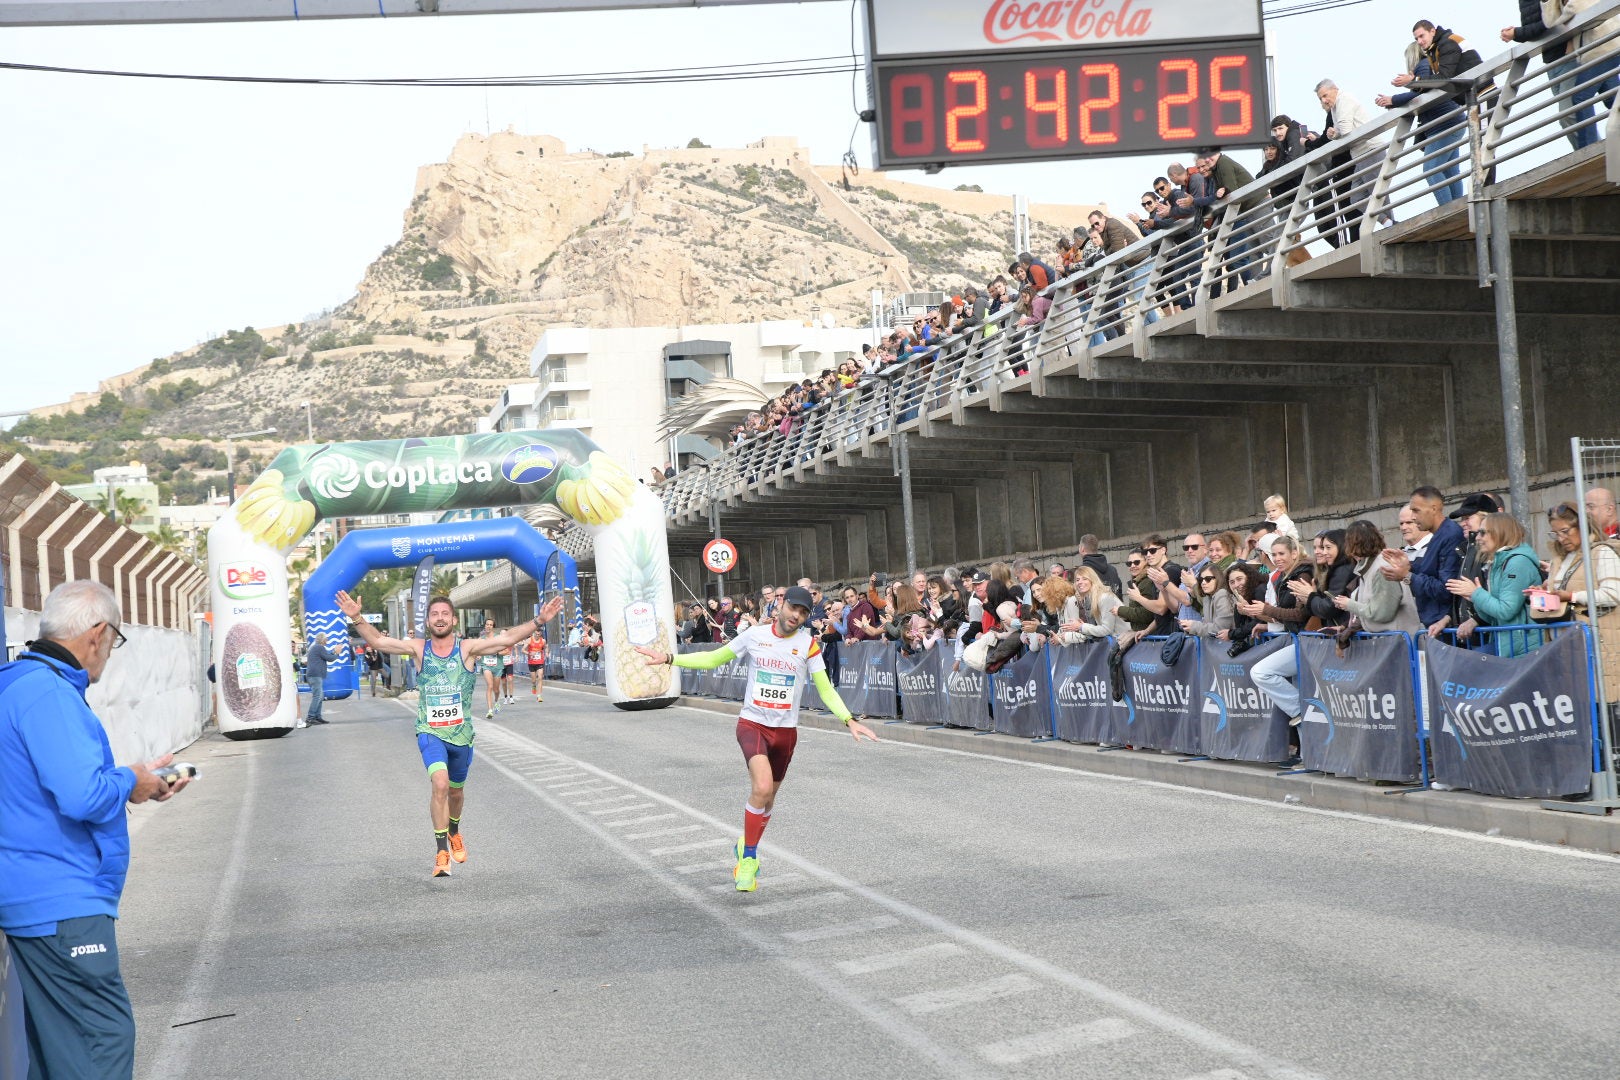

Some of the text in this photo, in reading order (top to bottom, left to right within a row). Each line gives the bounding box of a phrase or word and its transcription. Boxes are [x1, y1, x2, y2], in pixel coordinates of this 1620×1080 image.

[983, 0, 1153, 44] Coca-Cola
[363, 456, 493, 494] Coplaca
[416, 534, 476, 546] MONTEMAR
[711, 550, 730, 562] 30
[227, 567, 267, 584] Dole
[233, 607, 263, 615] EXOTICS
[414, 569, 430, 634] Alicante
[760, 687, 787, 700] 1586
[1222, 679, 1274, 710] Alican
[1326, 684, 1396, 720] Alicante
[431, 707, 458, 718] 2699
[1454, 691, 1575, 737] Alicante
